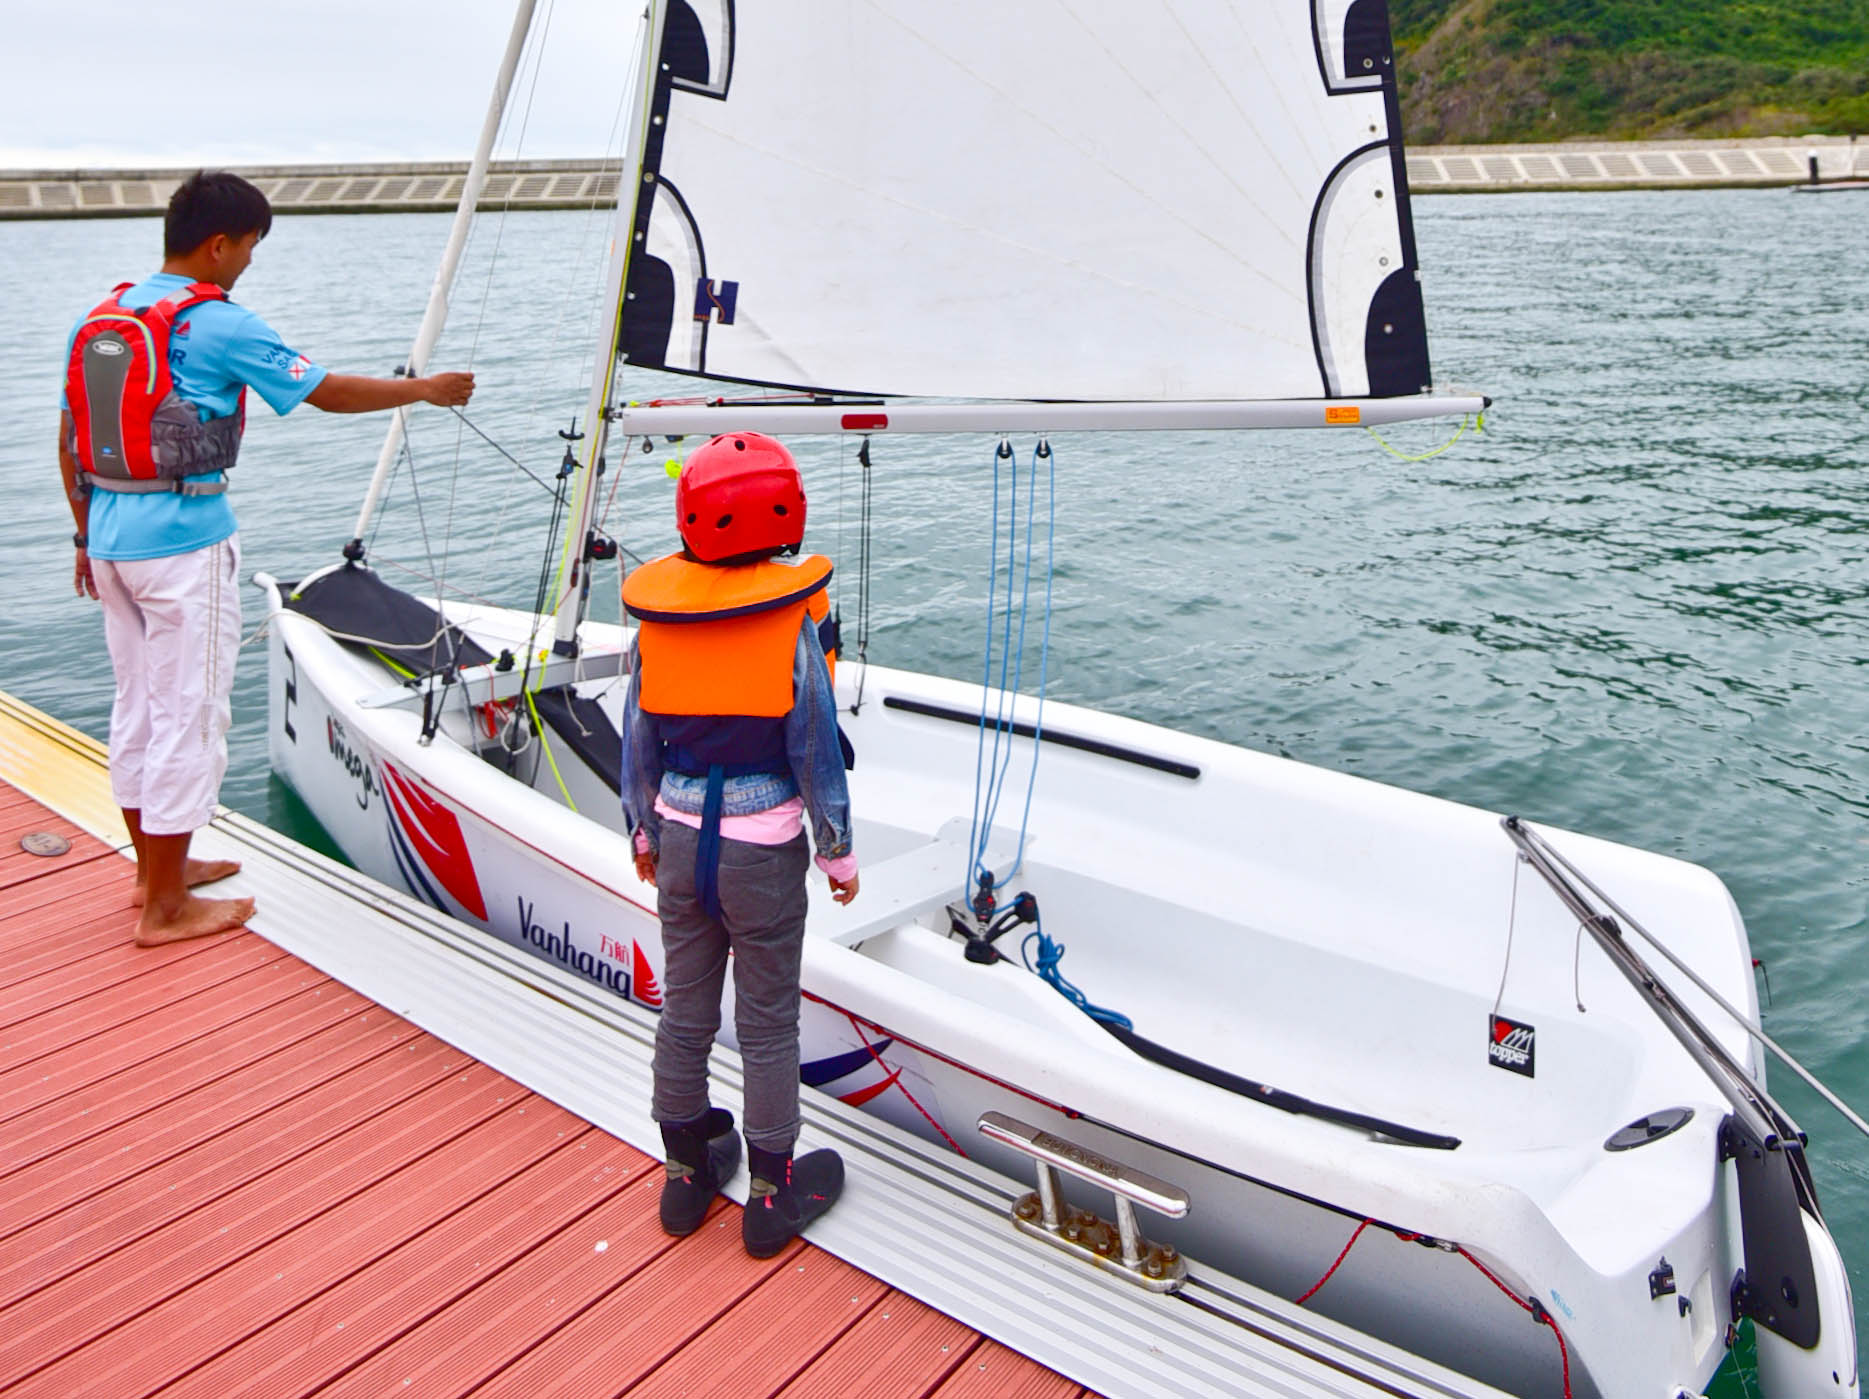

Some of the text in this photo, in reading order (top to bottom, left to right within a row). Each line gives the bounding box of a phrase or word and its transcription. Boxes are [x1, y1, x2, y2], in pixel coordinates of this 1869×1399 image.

[326, 714, 381, 811] Omega
[517, 895, 632, 1001] Vanhang
[599, 932, 631, 967] 万航
[1489, 1040, 1530, 1066] topper
